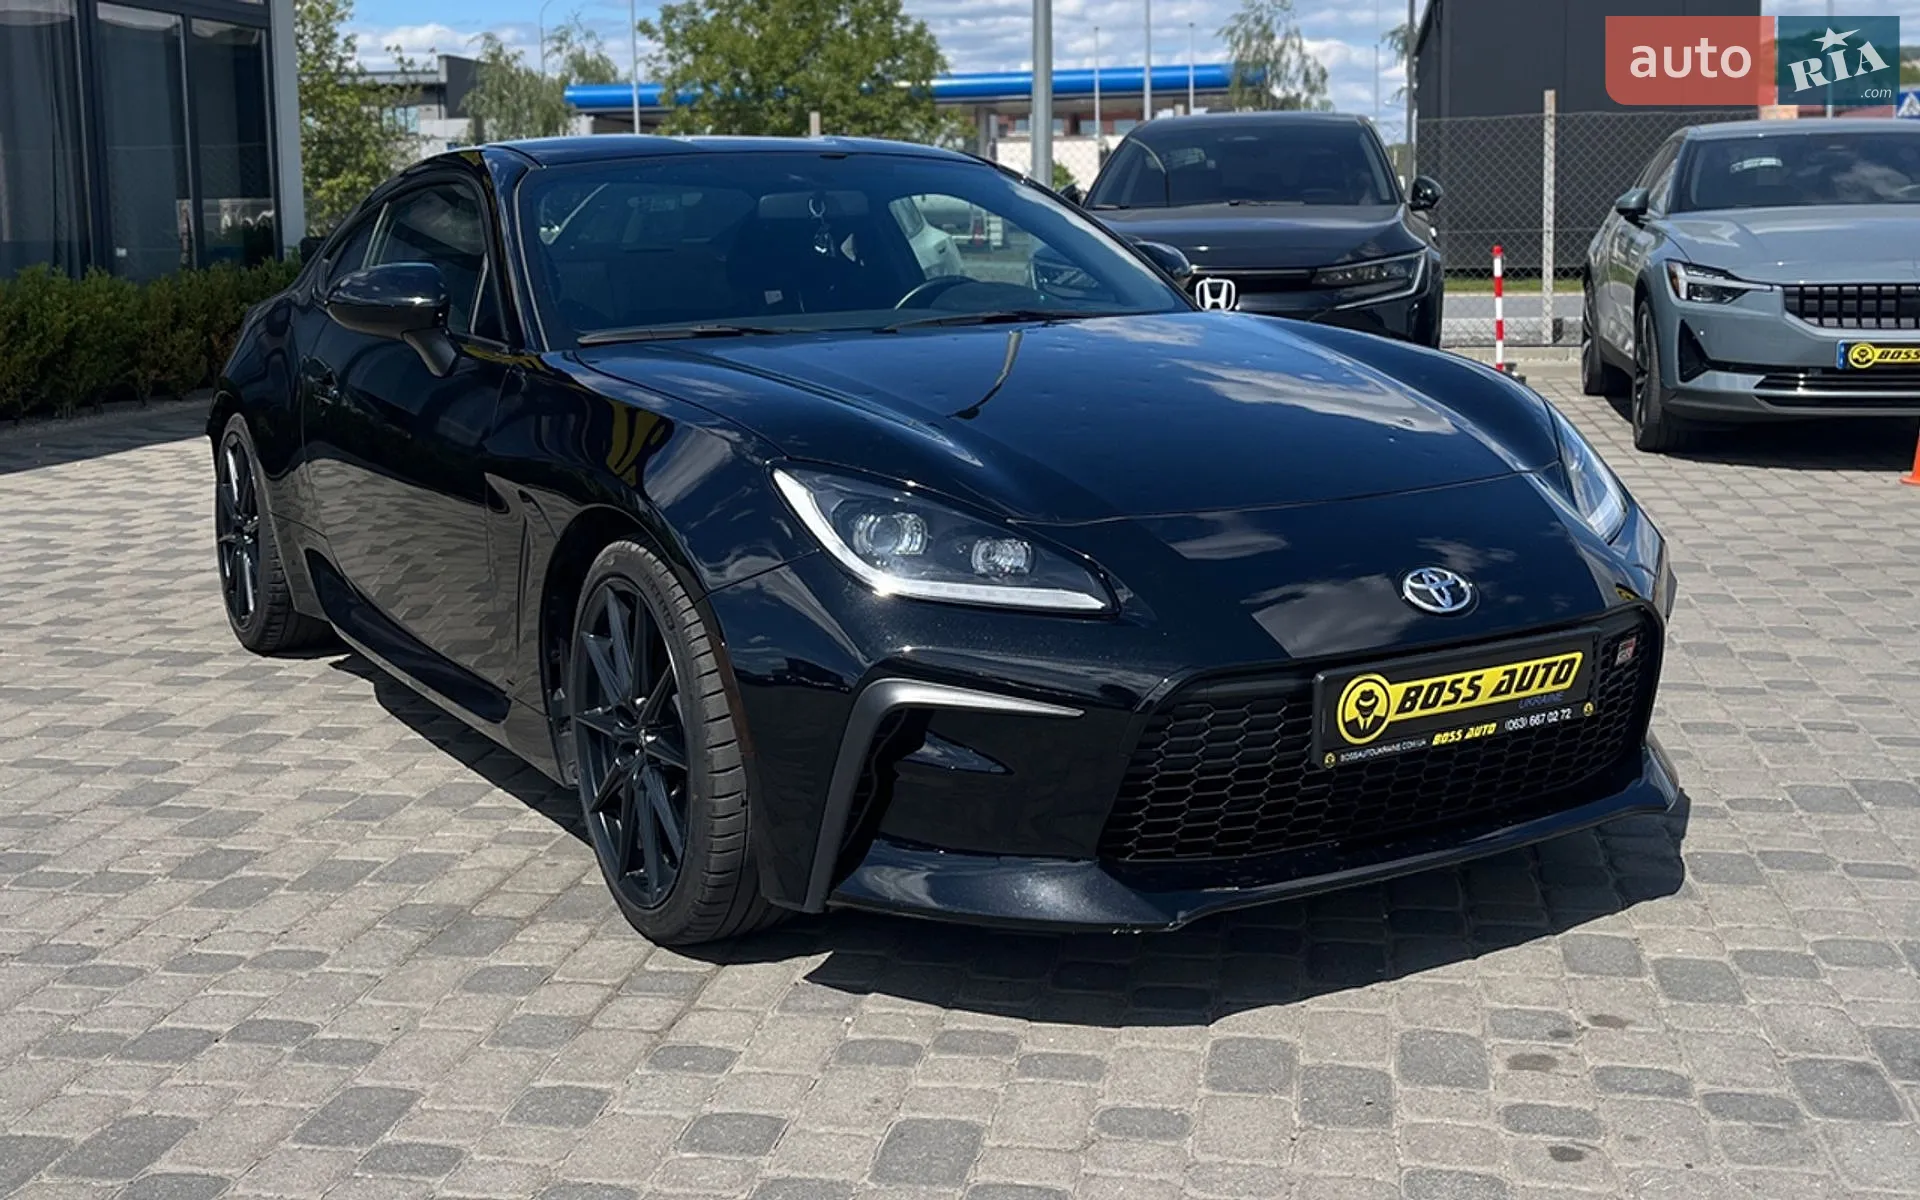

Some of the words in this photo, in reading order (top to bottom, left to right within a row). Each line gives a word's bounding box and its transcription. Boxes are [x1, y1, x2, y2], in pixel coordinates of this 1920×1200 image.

[1395, 674, 1484, 715] BOSS
[1488, 657, 1577, 699] AUTO
[1432, 729, 1463, 746] BOSS
[1464, 722, 1497, 740] AUTO
[1505, 716, 1528, 731] (063)
[1529, 712, 1546, 727] 667
[1547, 709, 1559, 723] 02
[1560, 707, 1572, 720] 72
